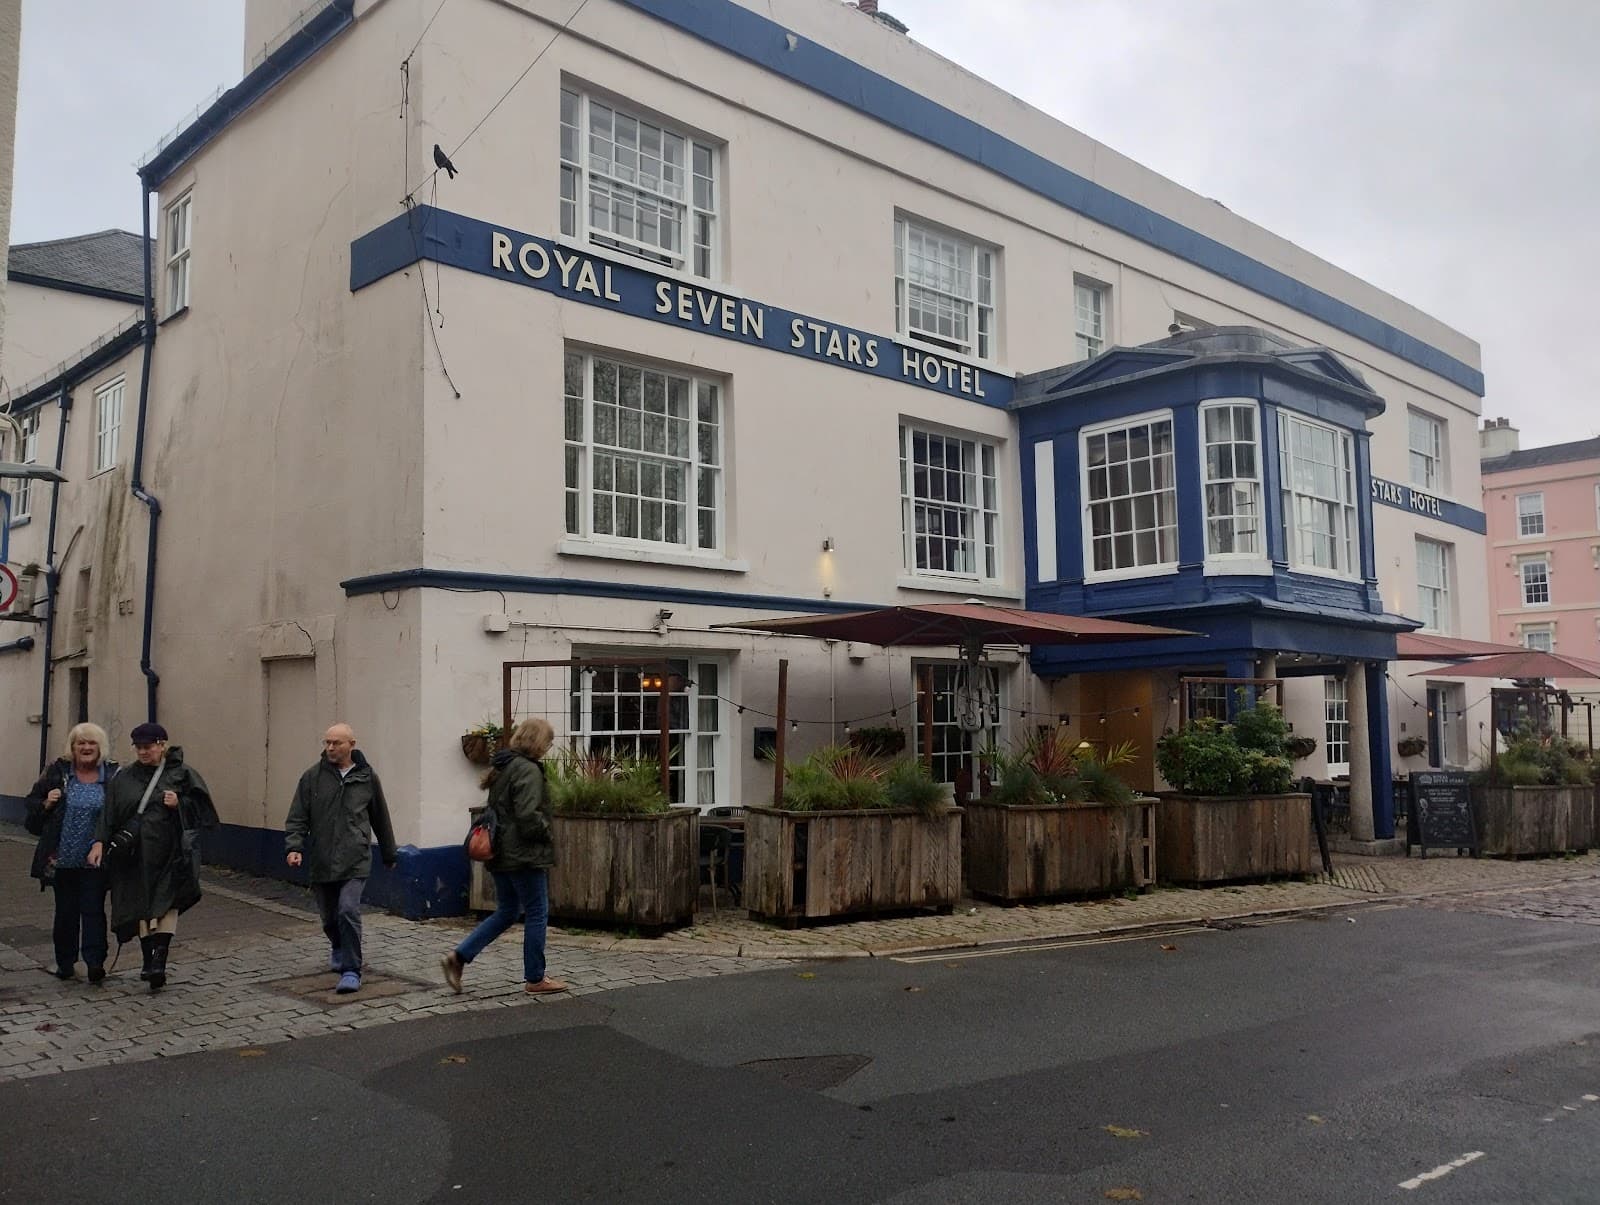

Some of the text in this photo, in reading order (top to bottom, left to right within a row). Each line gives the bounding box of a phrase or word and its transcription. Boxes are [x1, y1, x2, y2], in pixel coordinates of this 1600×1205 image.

[492, 231, 985, 397] ROYAL SEVEN STARS HOTEL
[1371, 480, 1442, 516] STARS HOTEL
